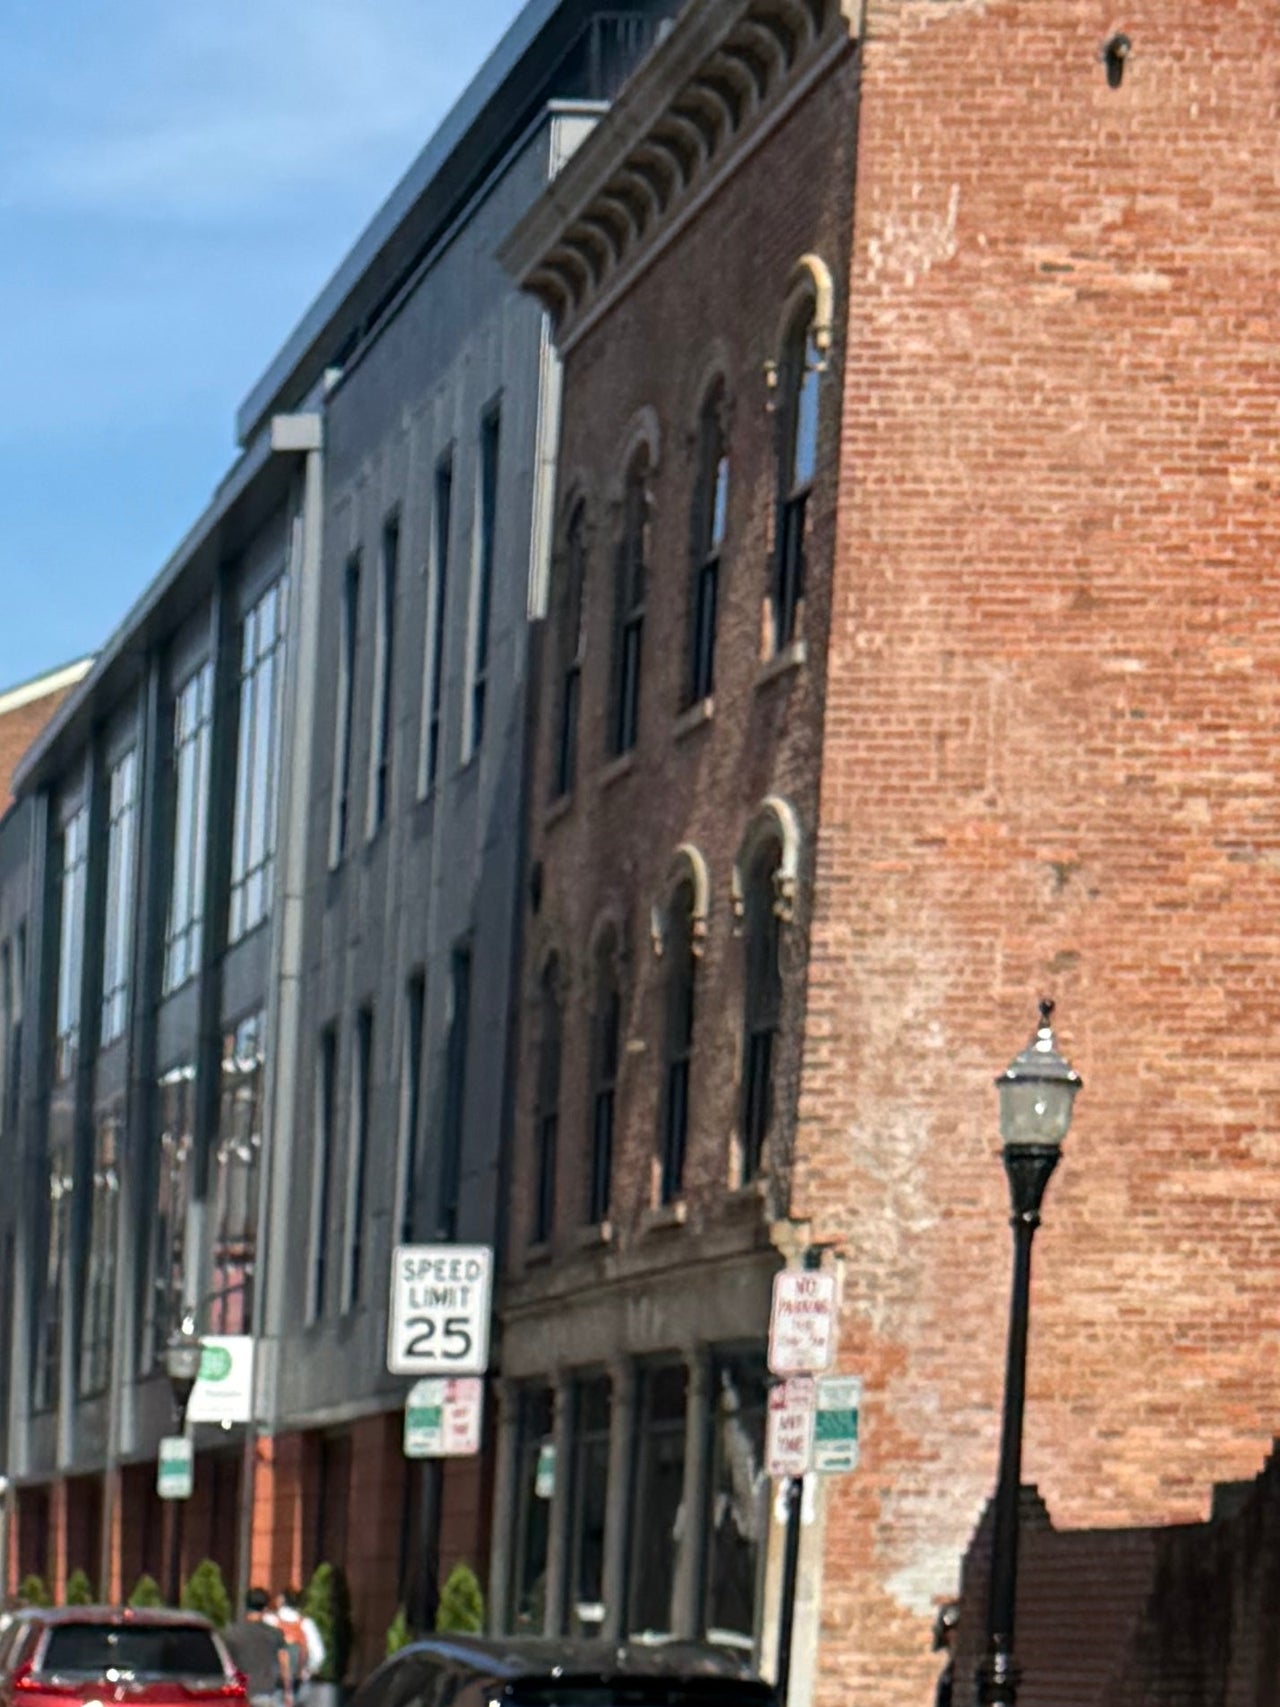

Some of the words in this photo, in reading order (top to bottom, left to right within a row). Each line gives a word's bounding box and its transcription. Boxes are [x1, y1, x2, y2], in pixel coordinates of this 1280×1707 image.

[402, 1258, 481, 1282] SPEED
[408, 1286, 471, 1308] LIMIT
[796, 1277, 817, 1296] NO
[778, 1299, 828, 1315] PARKING
[404, 1316, 473, 1359] 25
